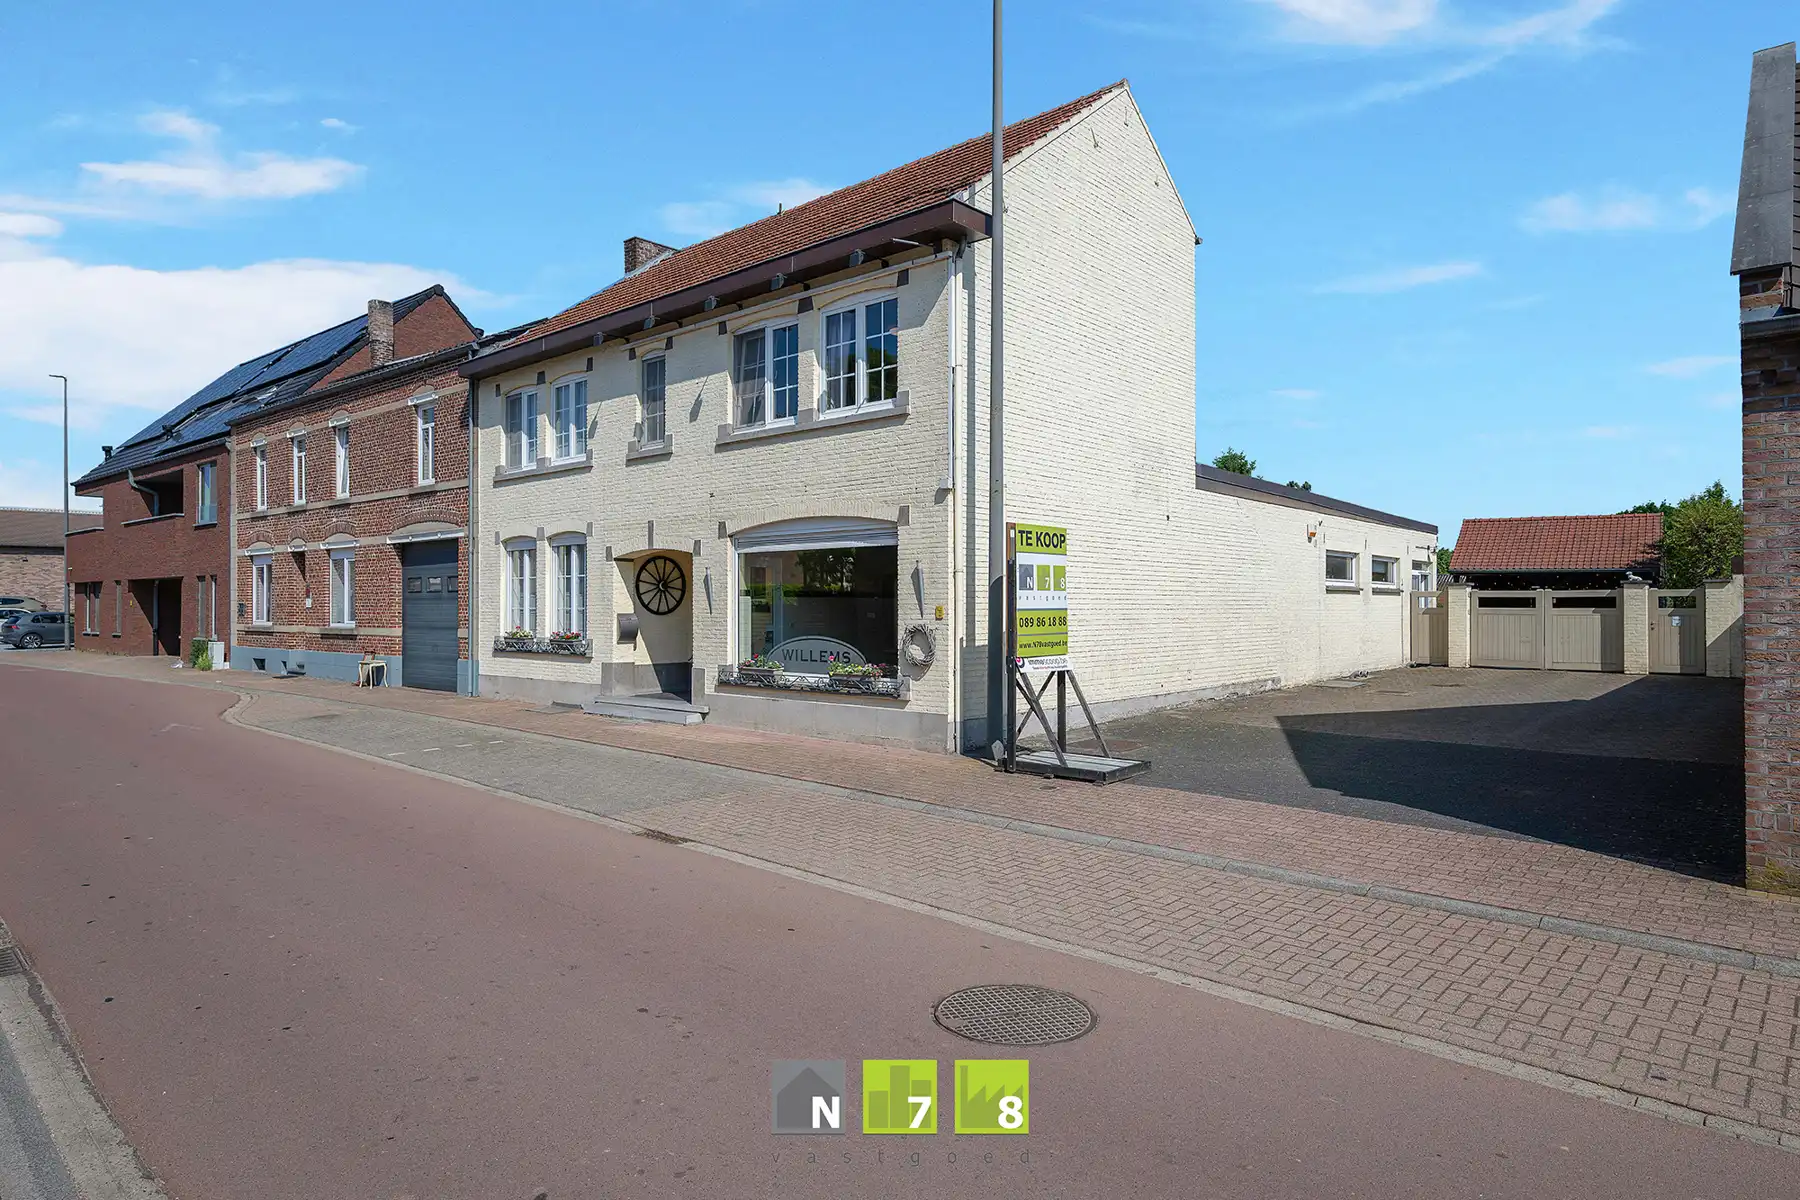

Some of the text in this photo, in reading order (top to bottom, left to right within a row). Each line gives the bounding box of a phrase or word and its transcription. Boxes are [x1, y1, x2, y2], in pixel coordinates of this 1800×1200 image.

[1018, 530, 1066, 548] TE KOOP
[1026, 576, 1065, 588] N 7 8
[1019, 616, 1067, 628] 089 86 18 88
[782, 649, 851, 664] WILLEMS
